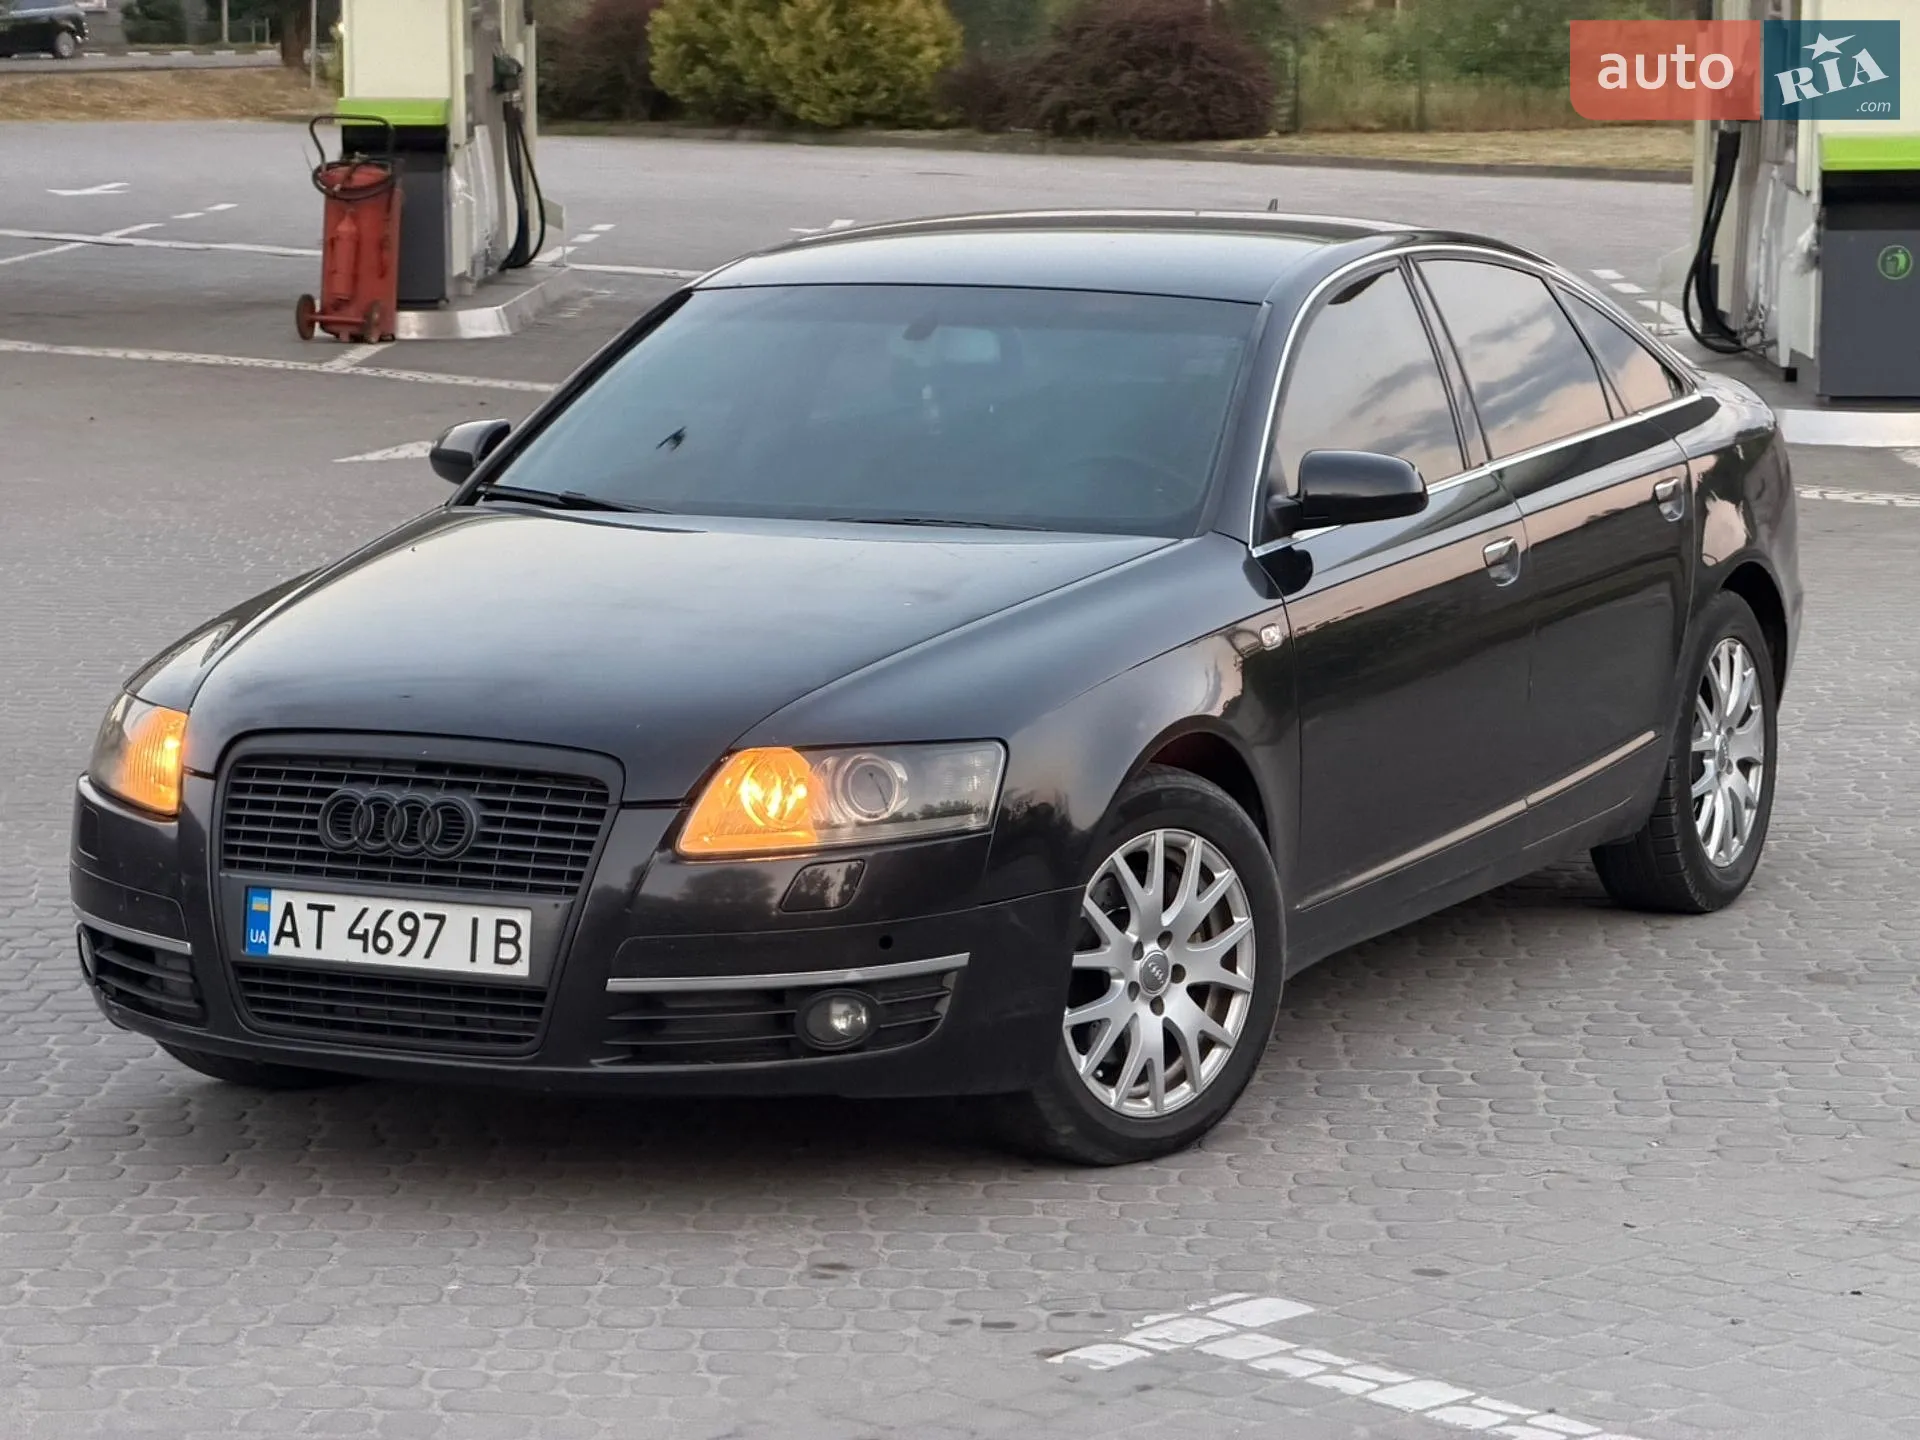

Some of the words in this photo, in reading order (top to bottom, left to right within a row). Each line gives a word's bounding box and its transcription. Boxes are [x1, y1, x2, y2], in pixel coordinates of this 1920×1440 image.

[250, 928, 267, 944] UA
[274, 901, 336, 950] AT
[347, 907, 447, 959] 4697
[470, 916, 523, 966] IB
